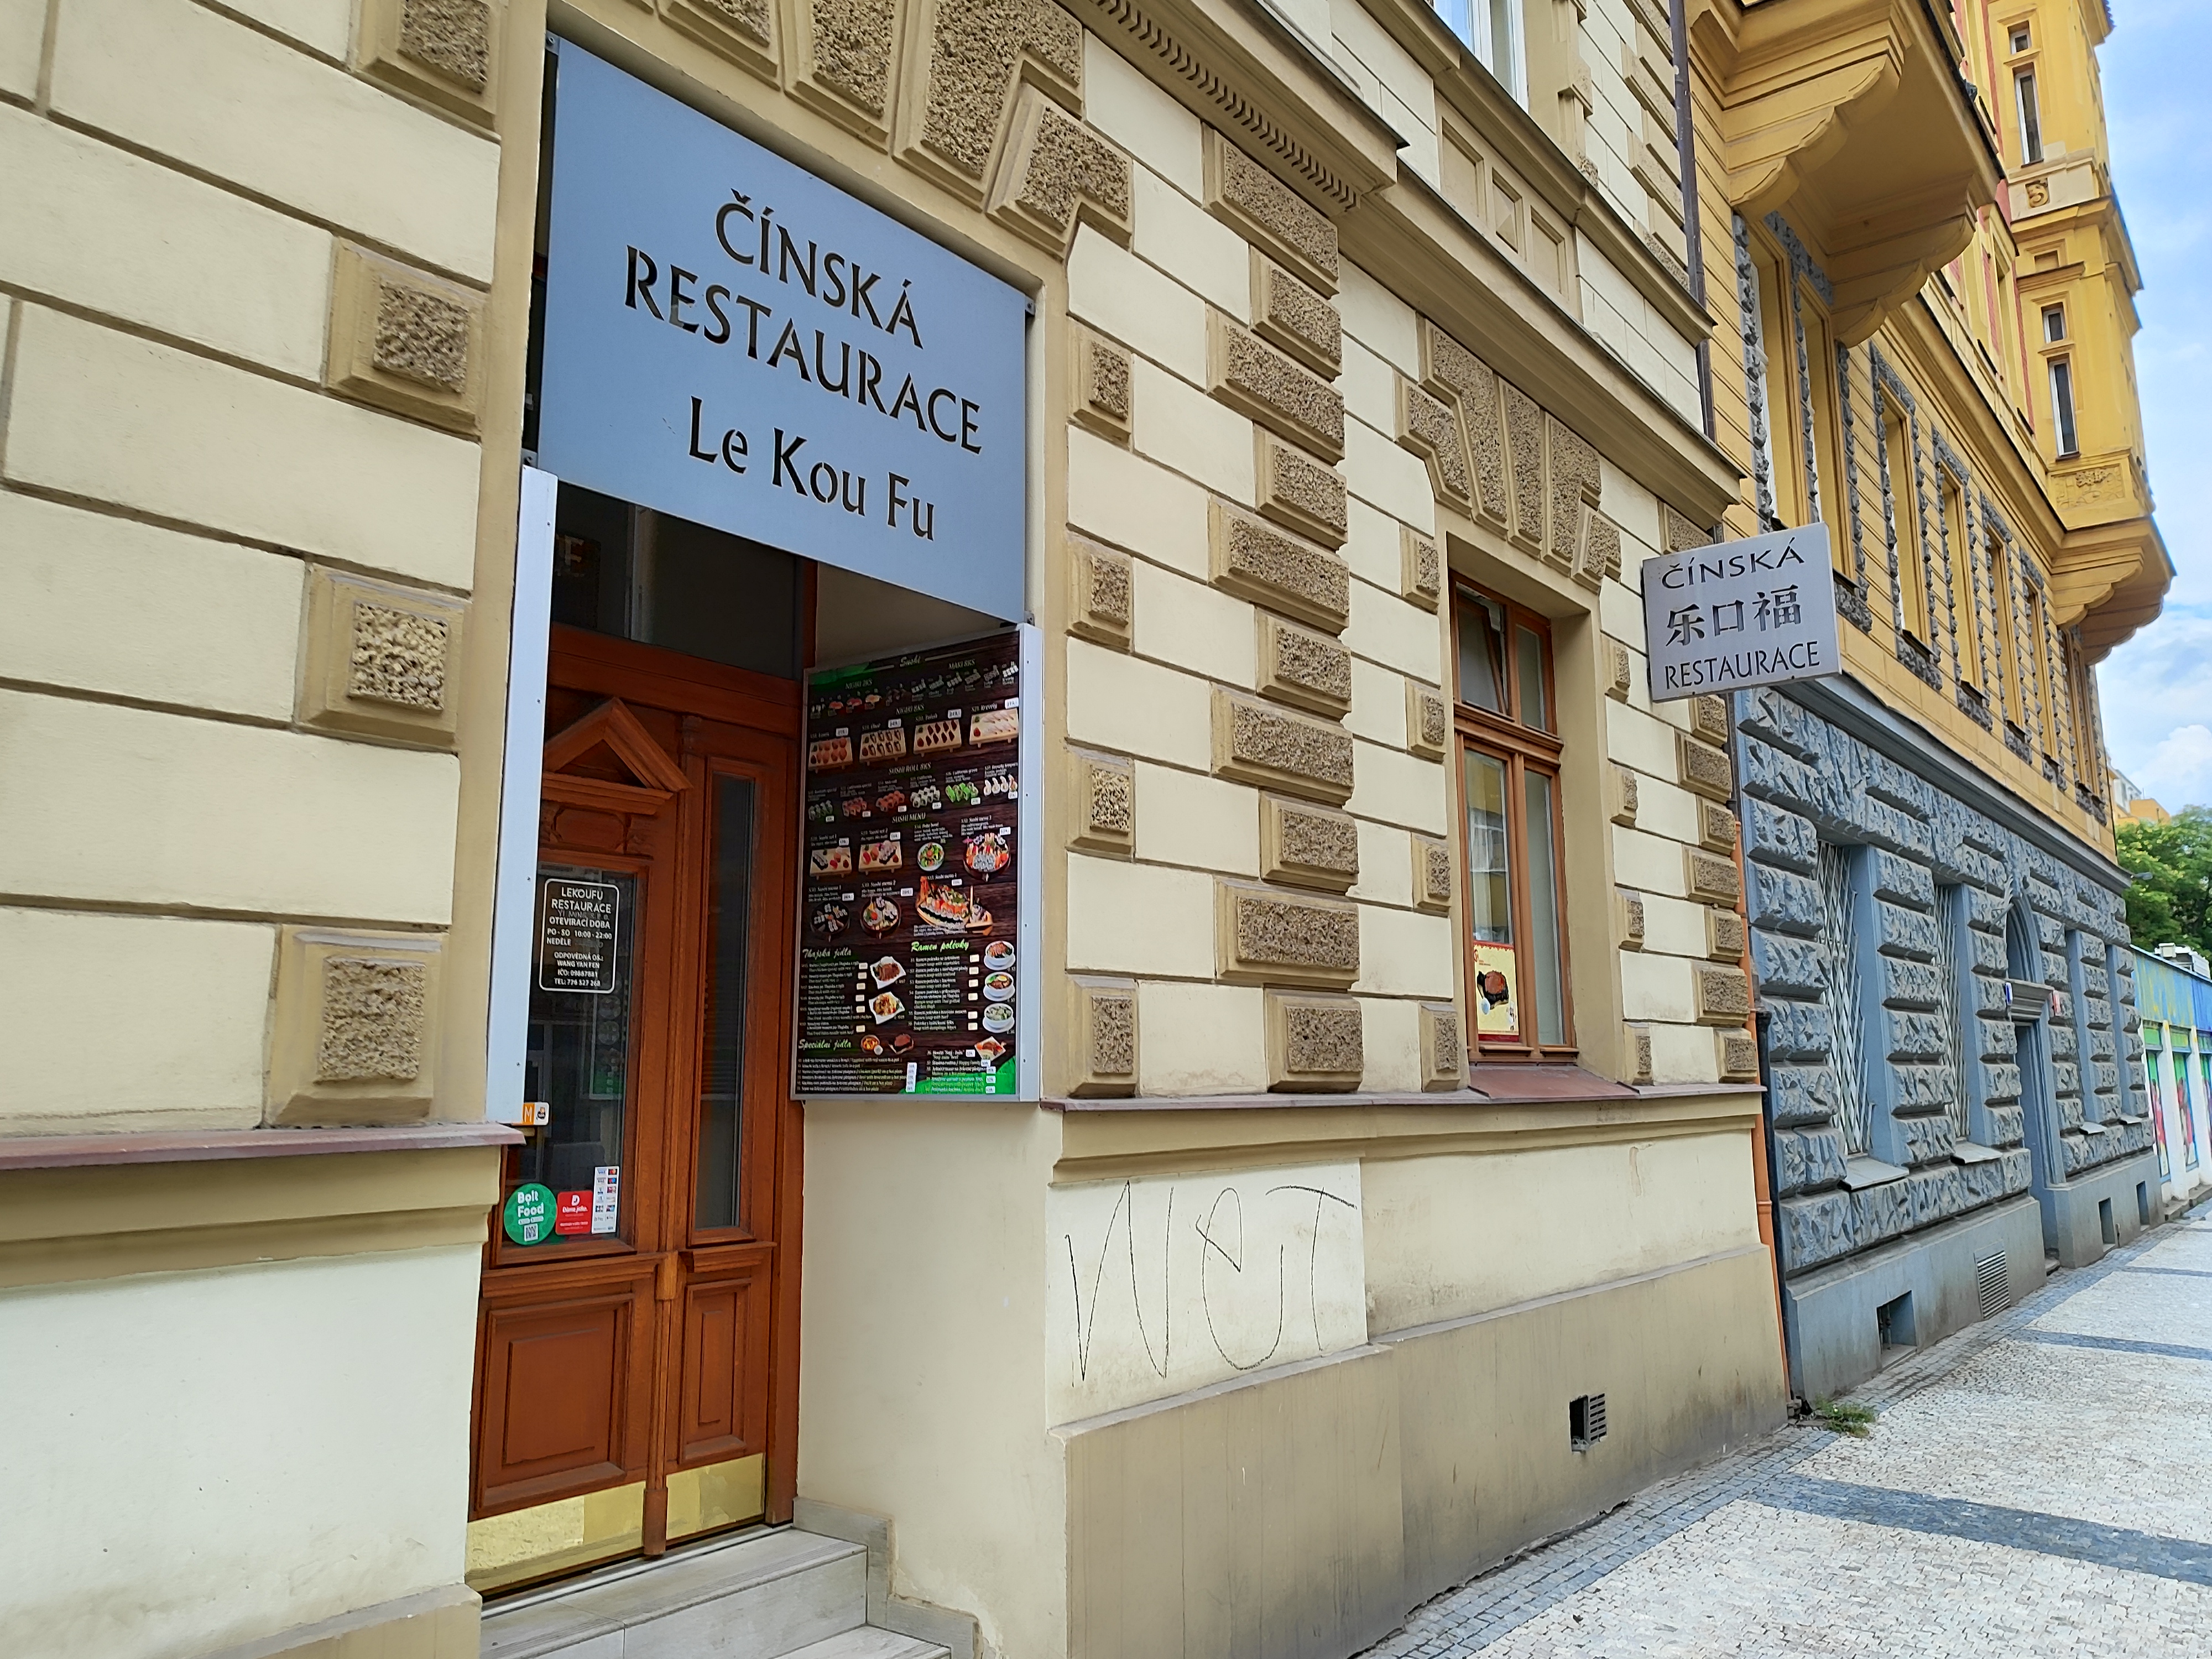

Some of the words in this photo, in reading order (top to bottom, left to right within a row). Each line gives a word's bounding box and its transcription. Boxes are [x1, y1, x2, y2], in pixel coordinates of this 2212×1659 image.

[716, 188, 923, 349] ČÍNSKÁ
[625, 244, 982, 455] RESTAURACE
[689, 395, 748, 474] Le
[772, 427, 866, 517] Kou
[887, 472, 935, 541] Fu
[1661, 537, 1804, 589] ČÍNSKÁ
[1666, 584, 1802, 647] 乐口福
[1665, 640, 1820, 690] RESTAURACE
[888, 766, 905, 775] SUSHI
[906, 764, 919, 773] ROLL
[891, 814, 909, 823] SUSHI
[909, 812, 926, 821] MENU
[561, 886, 603, 900] LEKOUFU
[551, 898, 612, 914] RESTAURACE
[589, 919, 611, 929] DOBA
[574, 930, 591, 938] 10:00
[911, 941, 938, 952] Ramen
[940, 938, 969, 953] polévky
[802, 947, 831, 960] Thajská
[833, 1039, 852, 1051] jídla
[518, 1190, 539, 1204] Bolt
[518, 1202, 544, 1218] Food
